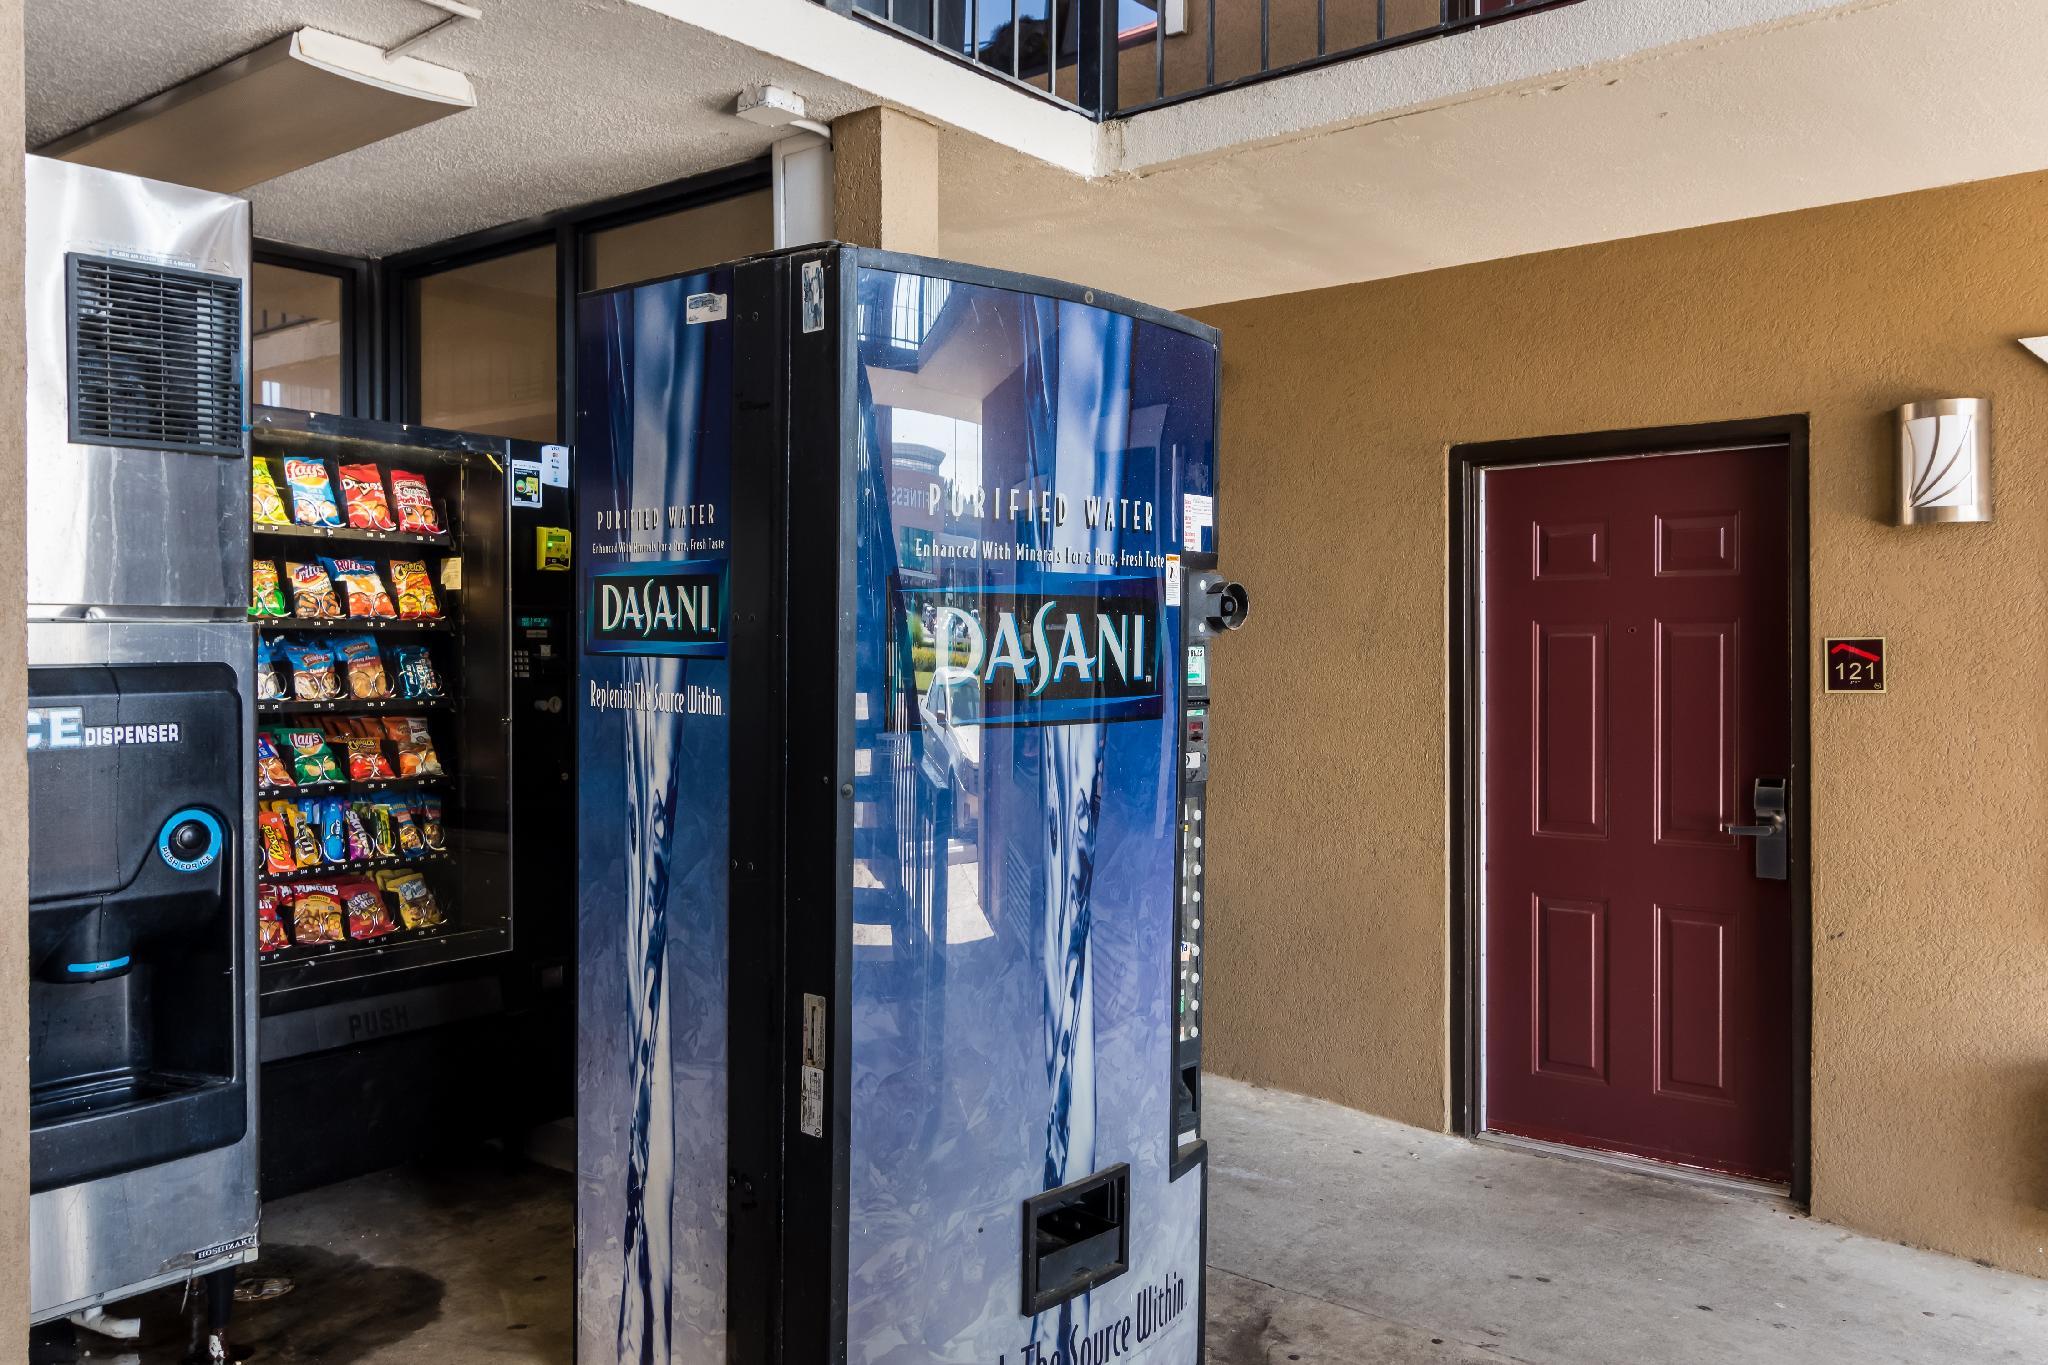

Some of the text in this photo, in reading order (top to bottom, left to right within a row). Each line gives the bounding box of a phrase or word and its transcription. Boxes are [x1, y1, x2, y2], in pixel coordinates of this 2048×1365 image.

[597, 503, 716, 530] PURIFIED WATER
[929, 483, 1068, 528] PURIFIED
[1084, 495, 1153, 531] WATER
[690, 538, 706, 550] Fresh
[915, 538, 977, 559] Enhanced
[982, 540, 1011, 560] With
[1121, 549, 1143, 568] Fresh
[1145, 550, 1165, 568] Taste
[601, 578, 711, 638] DASANI
[935, 600, 1144, 697] DASANI
[1835, 662, 1875, 680] 121
[590, 679, 633, 712] Replenish
[634, 682, 650, 711] The
[654, 683, 684, 713] Source
[85, 723, 179, 746] DISPENSER
[161, 846, 213, 870] PUSH FOR ICE
[349, 1005, 408, 1040] PUSH
[1070, 1316, 1131, 1365] Source
